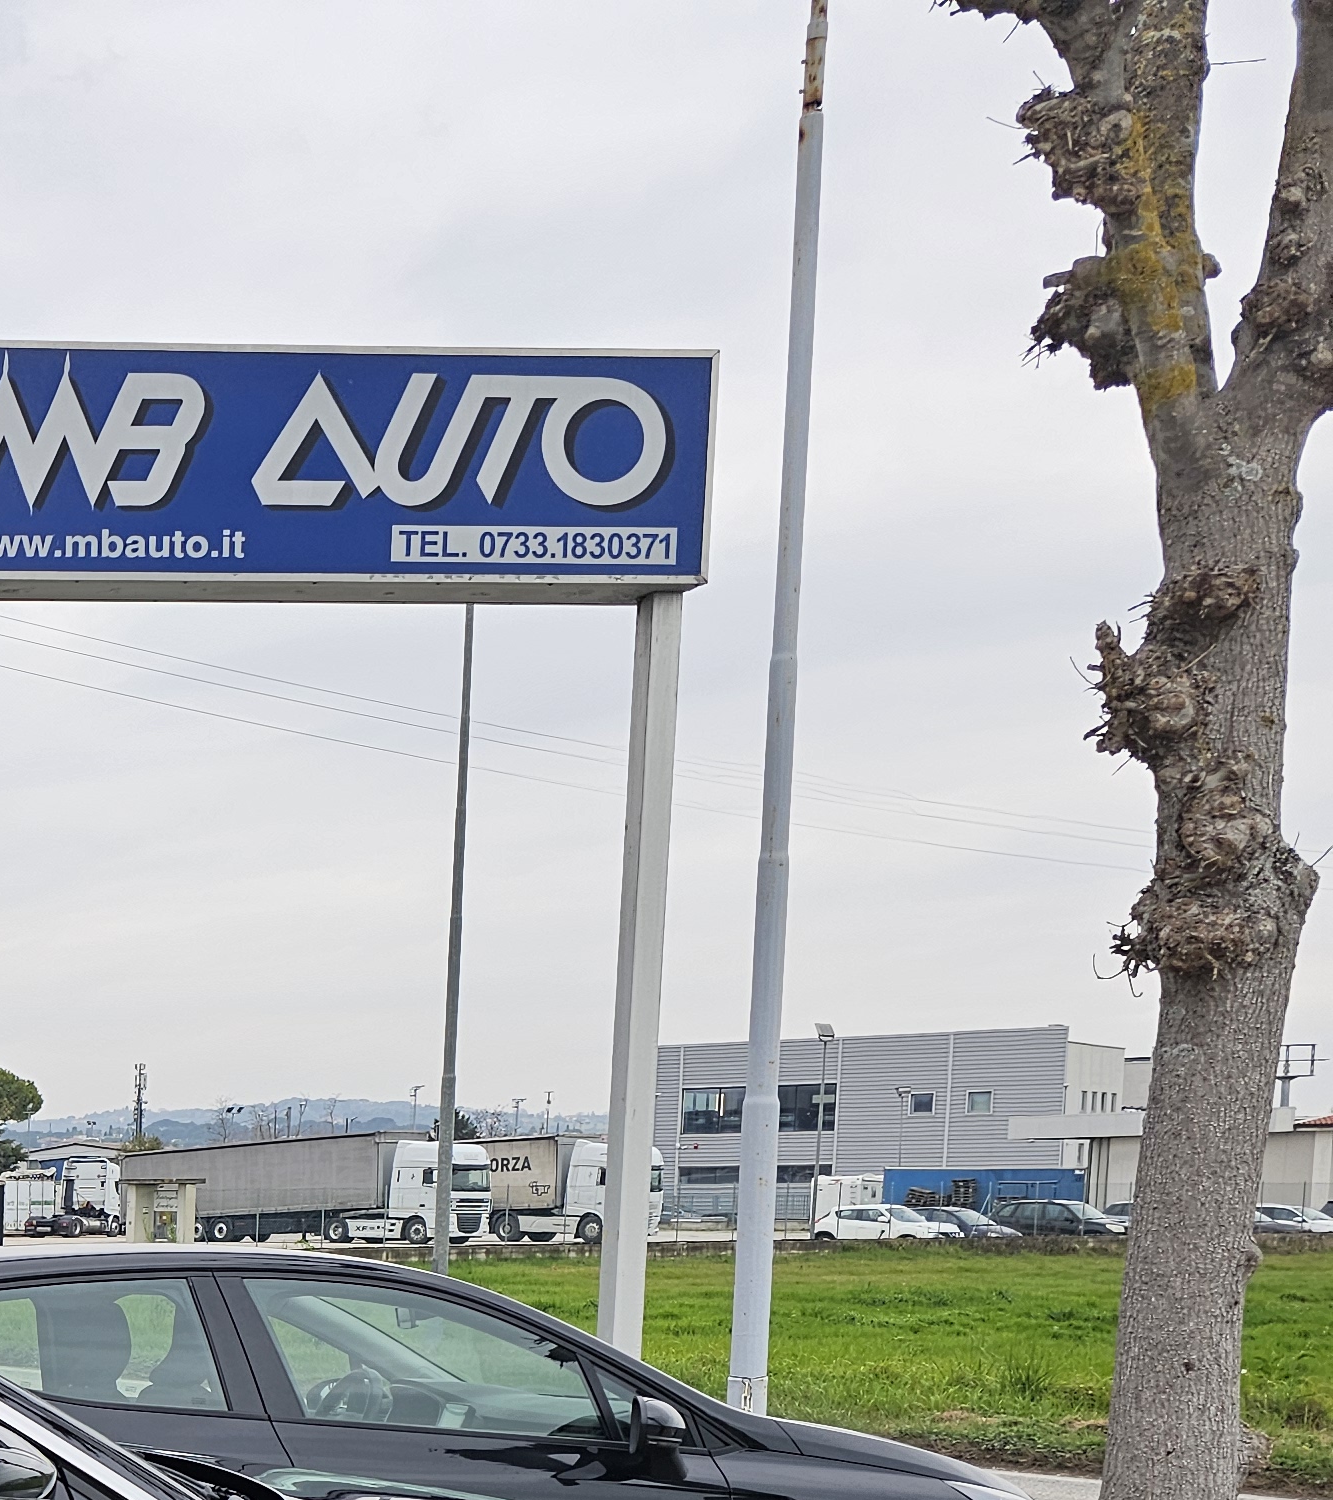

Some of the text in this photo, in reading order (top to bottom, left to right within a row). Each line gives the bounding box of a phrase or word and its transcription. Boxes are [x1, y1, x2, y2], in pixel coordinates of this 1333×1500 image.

[251, 370, 667, 508] AUTO
[399, 530, 673, 561] TEL. 0733.1830371
[490, 1155, 532, 1173] ORZA
